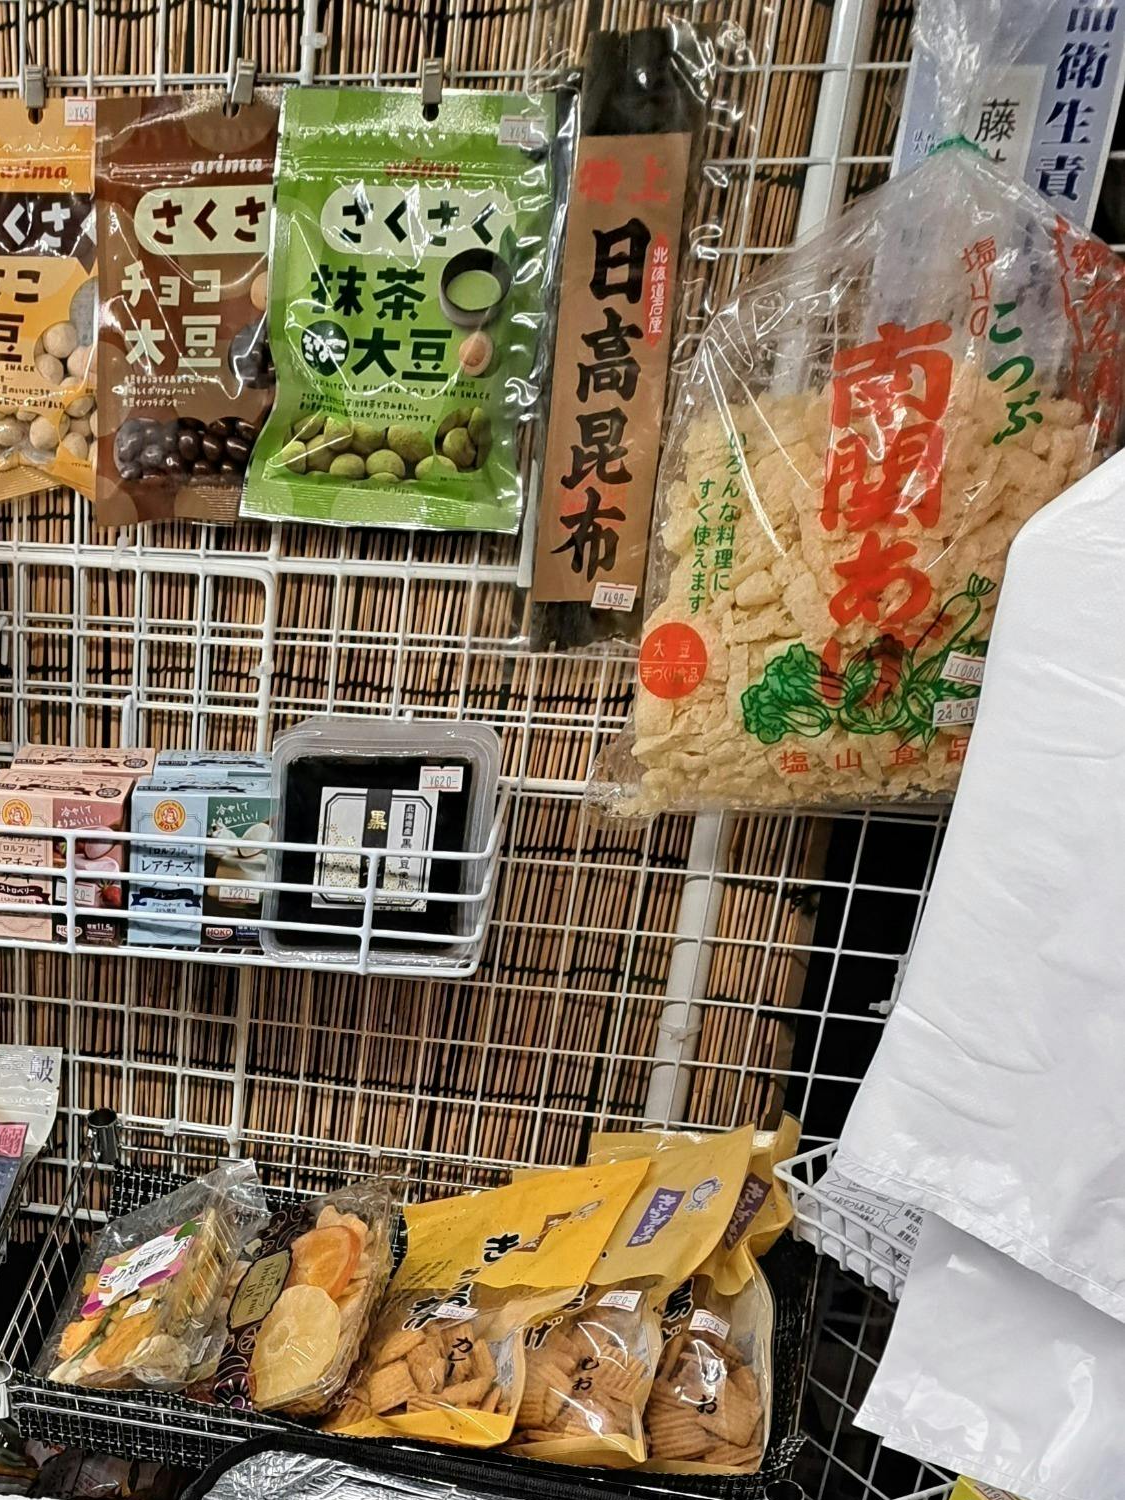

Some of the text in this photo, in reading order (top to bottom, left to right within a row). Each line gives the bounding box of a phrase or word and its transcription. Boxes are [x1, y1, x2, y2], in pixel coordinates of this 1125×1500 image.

[191, 154, 264, 174] arima
[341, 200, 497, 246] さくさく
[122, 260, 221, 306] チョコ
[311, 264, 426, 322] 抹茶
[962, 235, 996, 337] 塩山の
[125, 315, 221, 367] 大豆
[351, 327, 452, 382] 大豆
[5, 363, 35, 373] SNACK
[987, 301, 1043, 445] こつぶ
[461, 390, 491, 400] SNACK
[549, 217, 654, 582] 日高昆布
[713, 432, 747, 592] いろんな料理に
[689, 477, 715, 614] すぐ使えます
[653, 639, 691, 659] 大豆
[780, 736, 967, 773] 塩山食品
[61, 804, 92, 817] 冷やして
[216, 801, 249, 815] 冷やして
[142, 859, 195, 873] レアチーズ
[0, 886, 36, 895] ストロベリー
[206, 928, 232, 937] HOKO
[448, 1336, 474, 1379] カレー
[572, 1356, 600, 1391] しお
